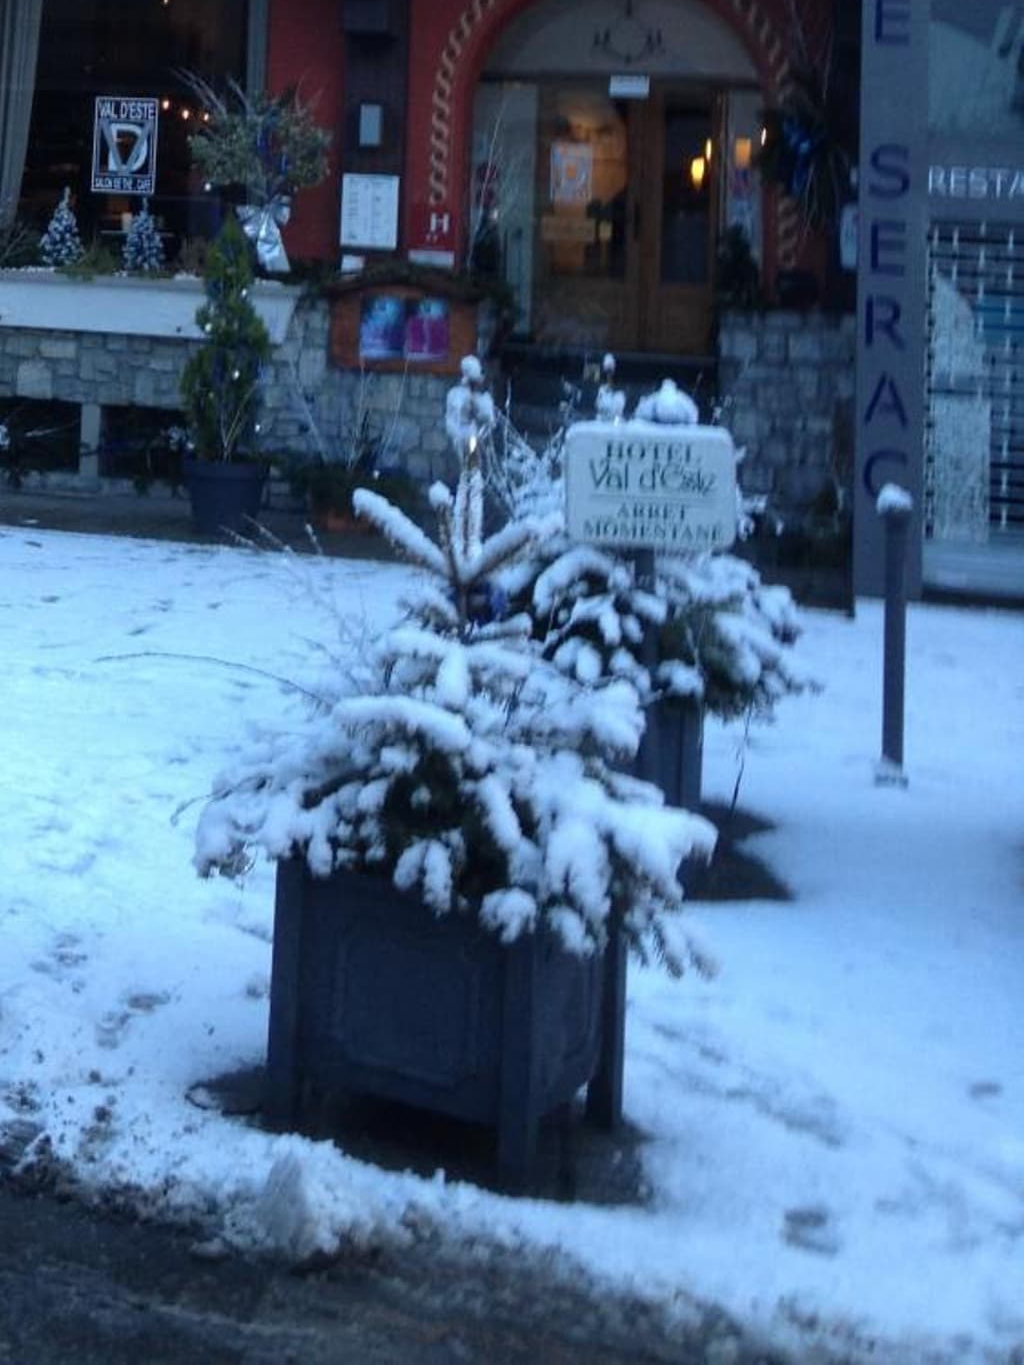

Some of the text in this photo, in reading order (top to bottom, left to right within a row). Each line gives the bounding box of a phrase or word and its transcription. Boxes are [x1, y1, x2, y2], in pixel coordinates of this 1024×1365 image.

[98, 100, 118, 118] VAL
[430, 212, 450, 234] H
[607, 442, 700, 464] HOTEL
[590, 458, 629, 492] Val
